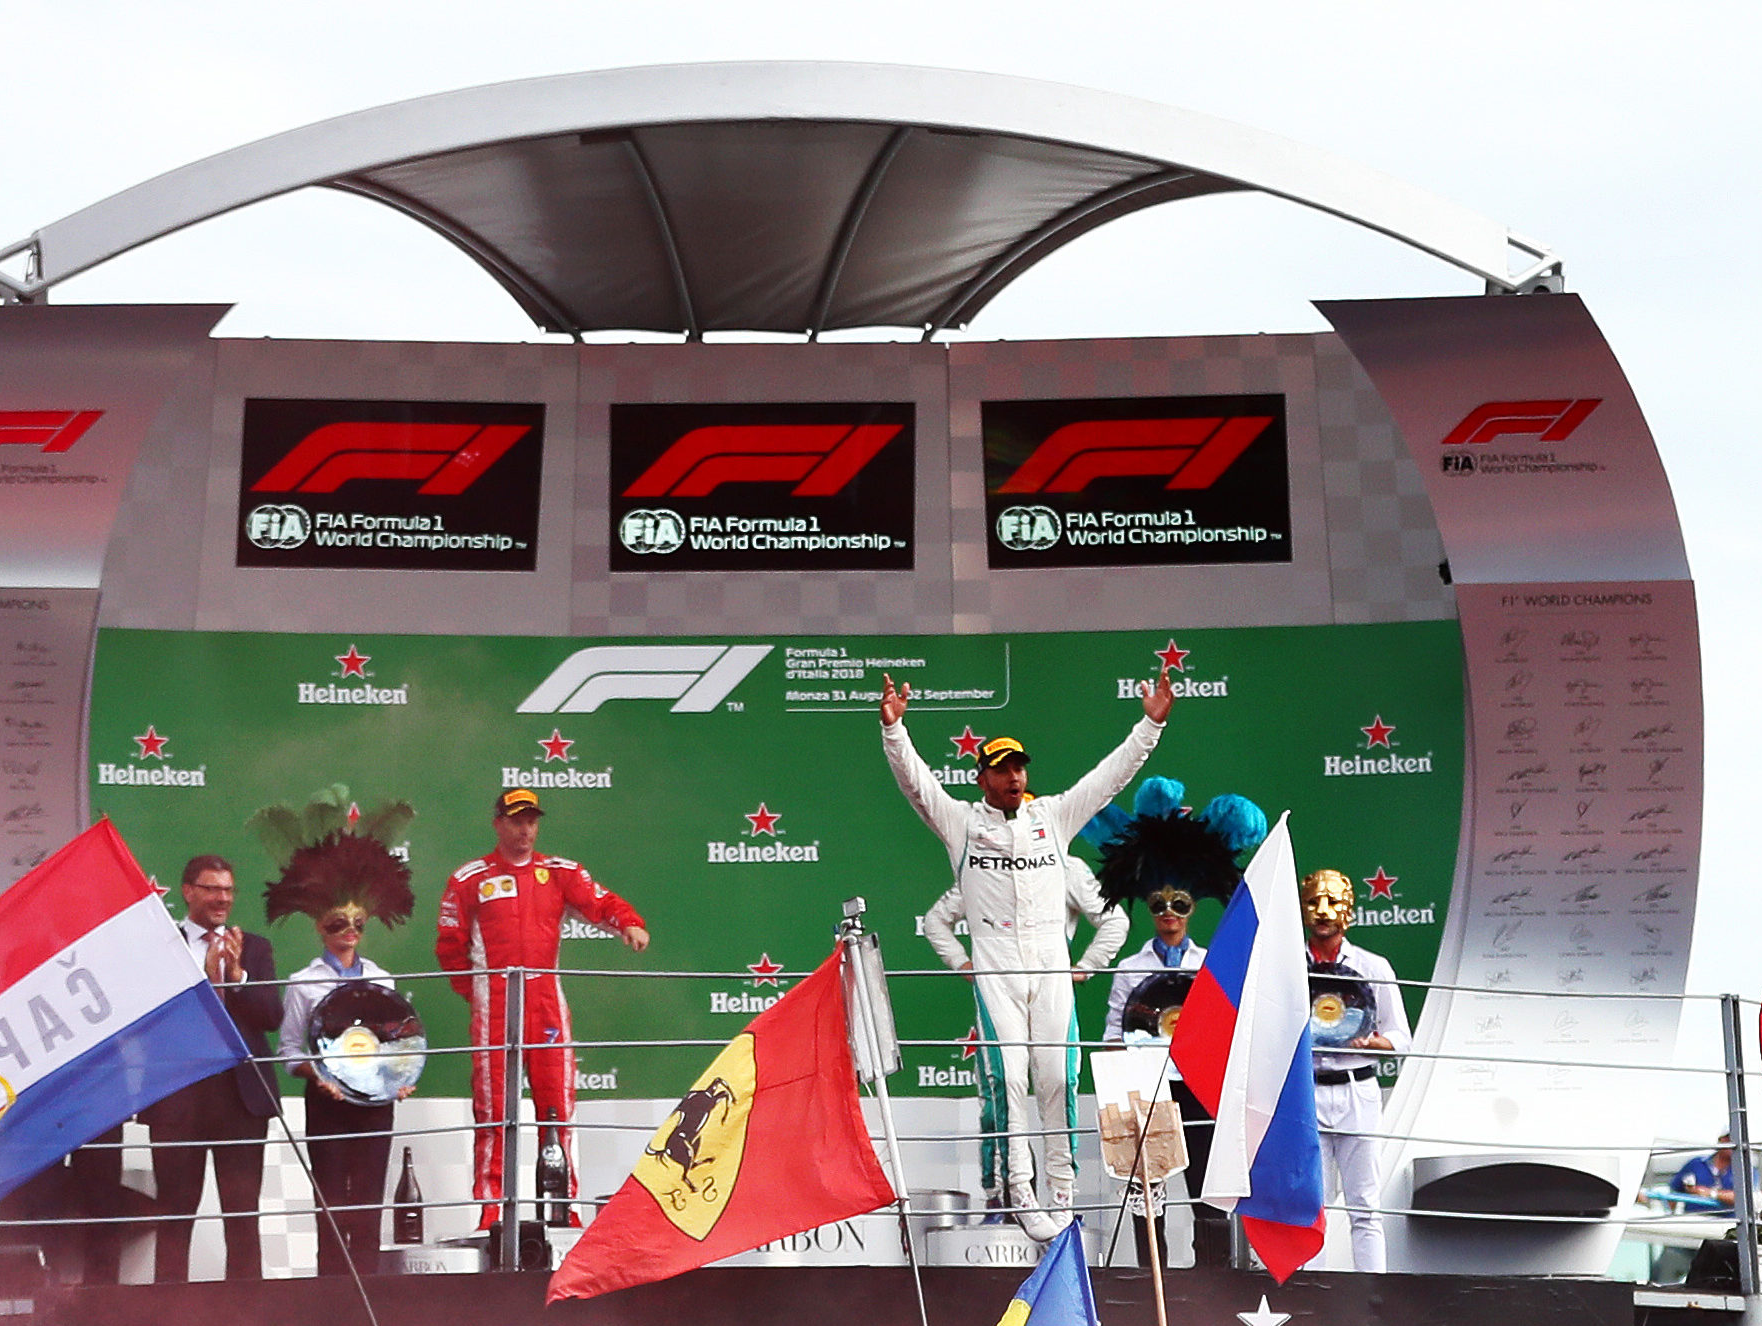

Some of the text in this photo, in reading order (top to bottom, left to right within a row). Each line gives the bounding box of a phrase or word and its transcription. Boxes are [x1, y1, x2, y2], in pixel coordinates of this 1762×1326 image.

[315, 513, 444, 530] FIA Formula 1
[690, 517, 820, 532] FIA Formula 1
[1066, 509, 1195, 528] FIA Formula 1
[315, 531, 512, 551] World Championship
[690, 533, 891, 551] World Championship
[1066, 529, 1124, 546] World
[1129, 526, 1267, 544] Championship
[1526, 595, 1571, 607] WORLD
[1573, 593, 1653, 606] CHAMPIONS
[786, 647, 847, 657] Formula 1
[786, 657, 926, 668] Gran Premio Heineken
[832, 669, 865, 679] 2018
[298, 684, 408, 705] Heineken
[786, 691, 830, 701] Monza
[832, 690, 847, 700] 31
[924, 688, 995, 701] September
[1324, 752, 1432, 777] Heineken
[98, 764, 206, 787] Heineken
[502, 768, 612, 789] Heineken
[707, 841, 819, 863] Heineken
[969, 854, 1056, 871] PETRONAS
